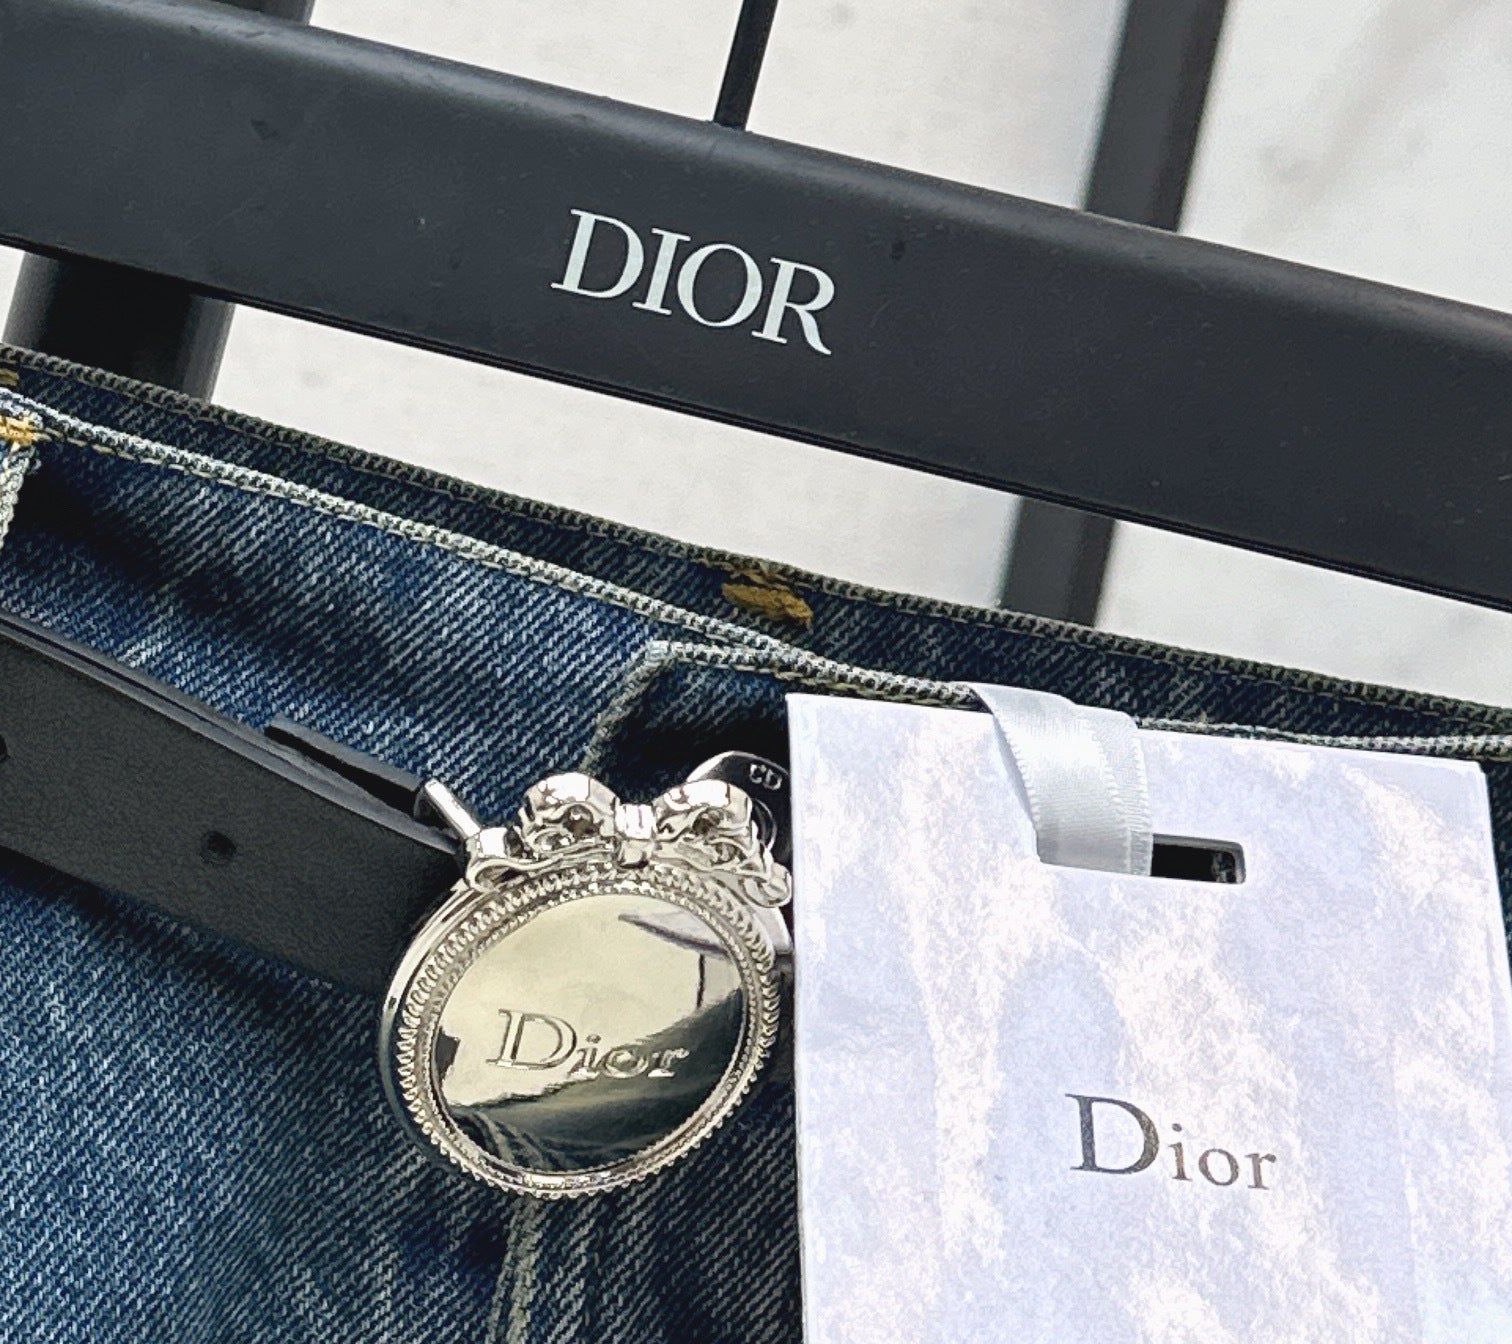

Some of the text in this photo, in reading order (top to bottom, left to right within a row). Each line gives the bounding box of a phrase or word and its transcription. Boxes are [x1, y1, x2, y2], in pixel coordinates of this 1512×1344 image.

[551, 209, 835, 355] DIOR
[750, 764, 783, 791] CD
[485, 1008, 690, 1079] Dior
[1065, 1093, 1277, 1190] Dior
